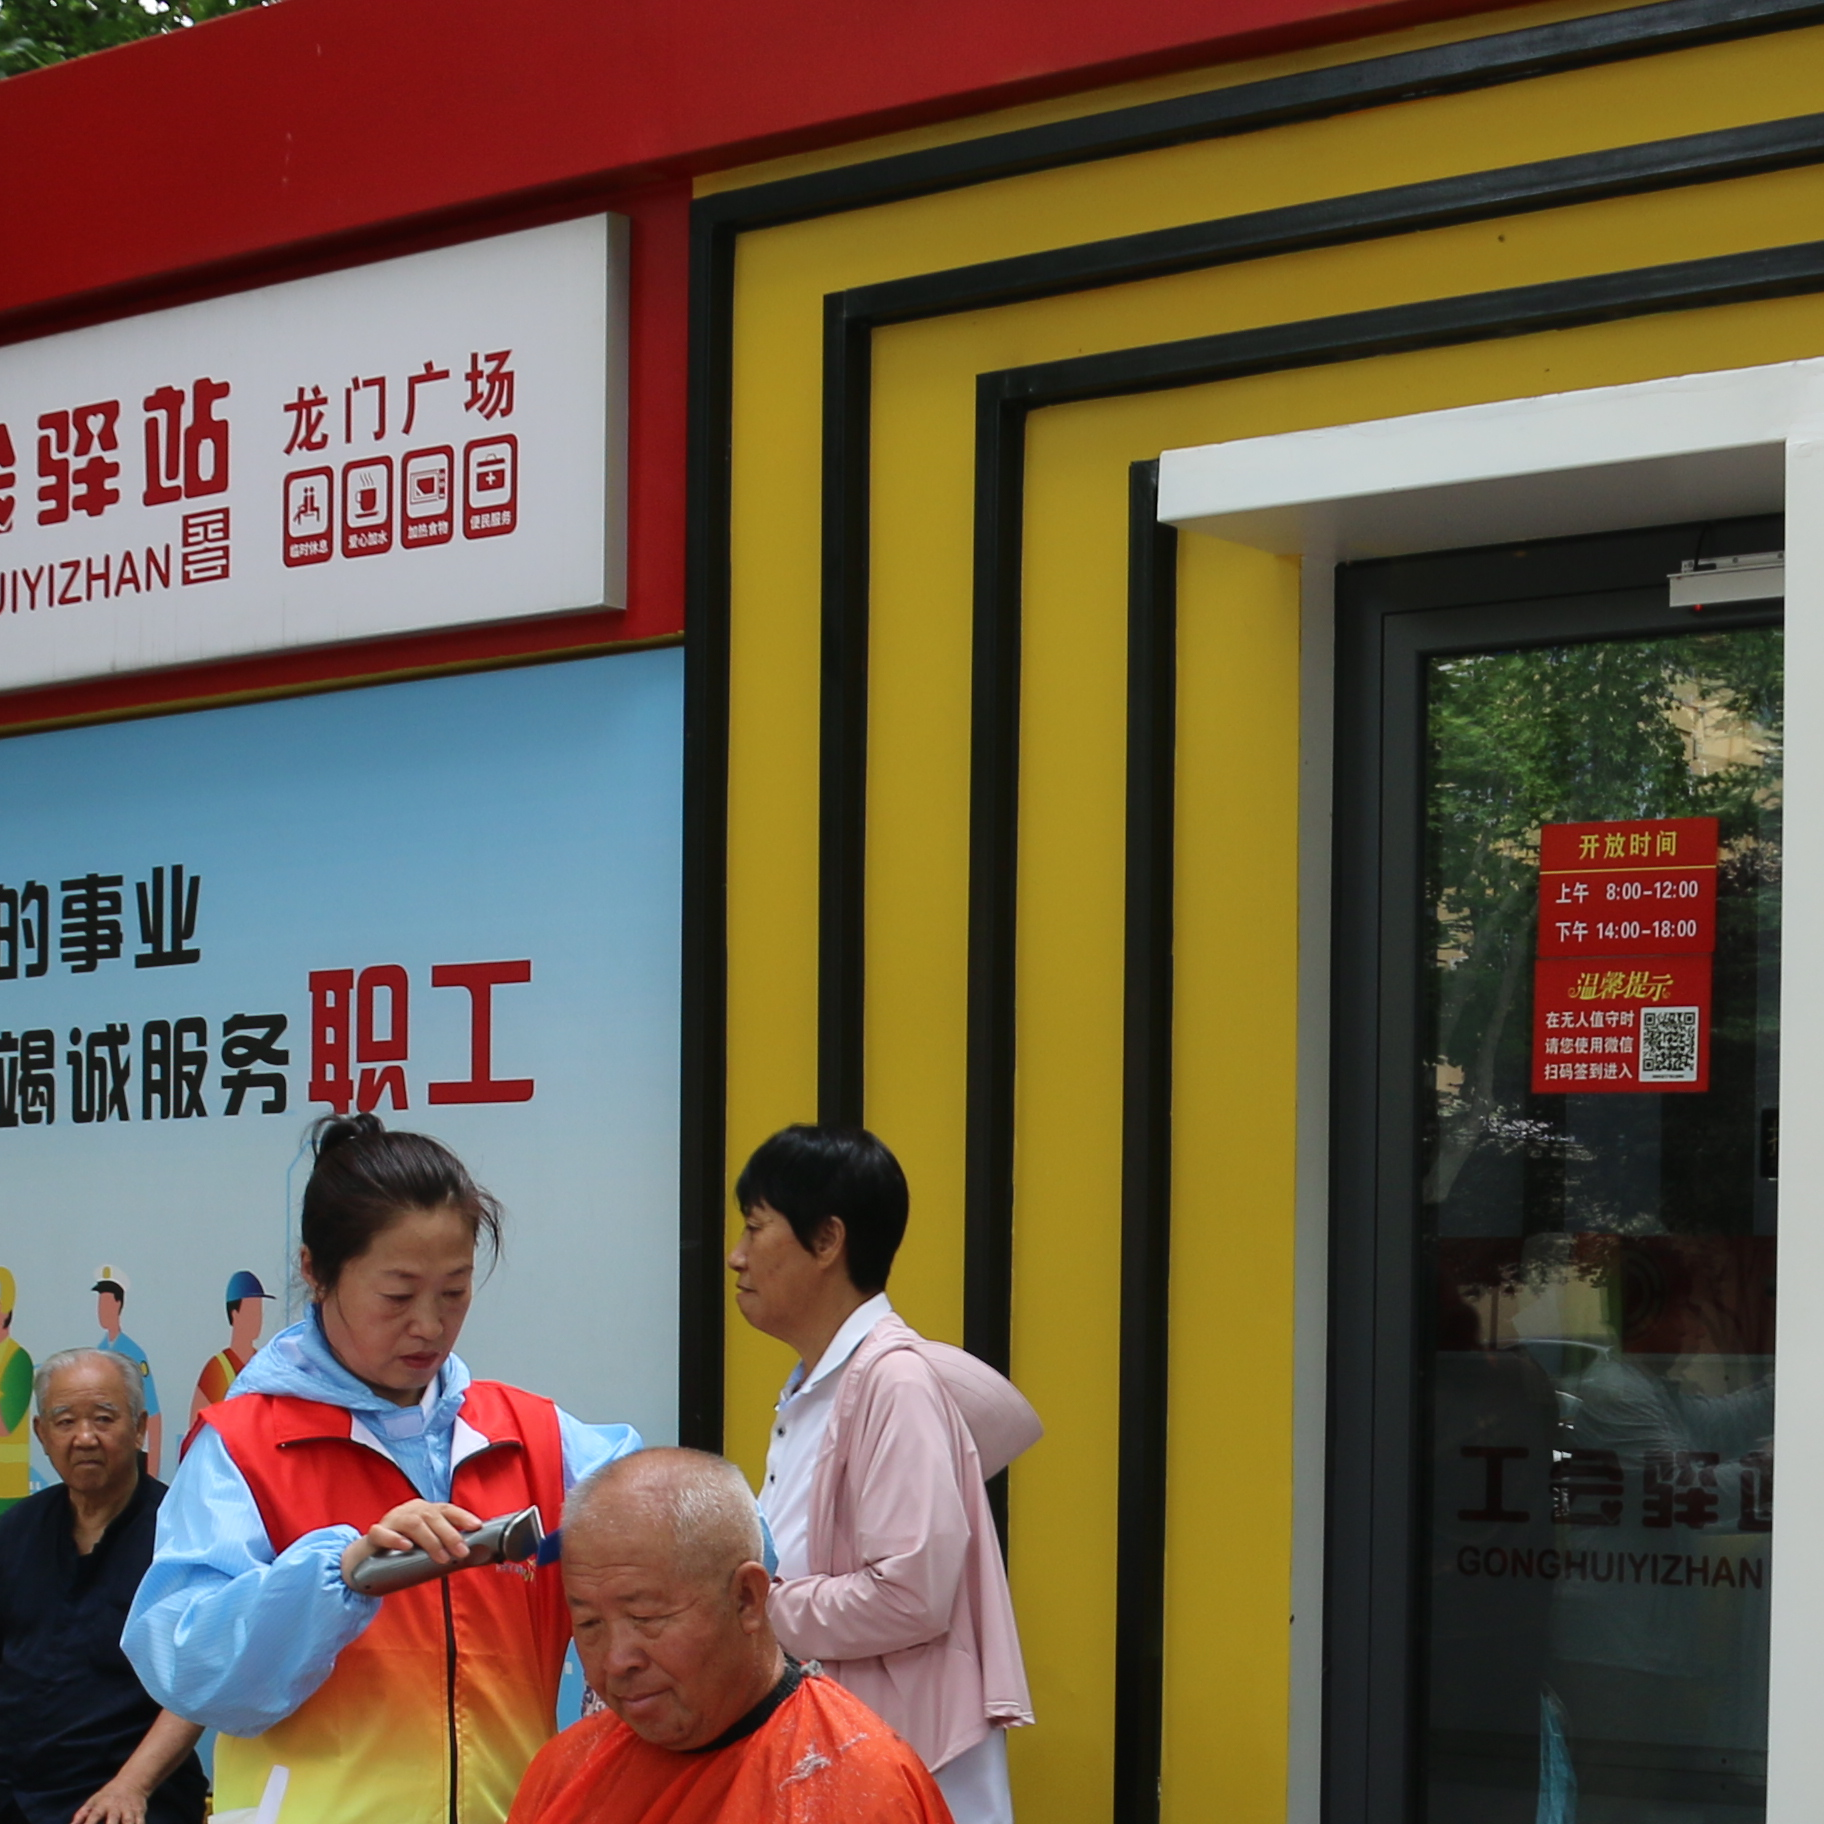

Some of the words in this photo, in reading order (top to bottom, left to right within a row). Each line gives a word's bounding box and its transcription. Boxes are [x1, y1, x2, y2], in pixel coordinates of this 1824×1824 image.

[283, 349, 515, 455] 龙门广场
[407, 520, 449, 540] 加热食物
[470, 510, 511, 530] 便民服务
[289, 538, 329, 558] 临时休息
[347, 529, 388, 549] 爱心加水
[1578, 830, 1677, 859] 开放时间
[1555, 882, 1589, 904] 上午
[1606, 880, 1699, 901] 8:00-12:00
[1555, 921, 1589, 943] 下午
[1596, 919, 1697, 940] 14:00-18:00
[1569, 971, 1674, 1002] 温馨提示
[1545, 1010, 1635, 1029] 在无人值守时
[1545, 1035, 1634, 1055] 请您使用微信
[1544, 1062, 1633, 1080] 扫码签到进入
[1457, 1545, 1763, 1590] GONGHUIYIZHAN
